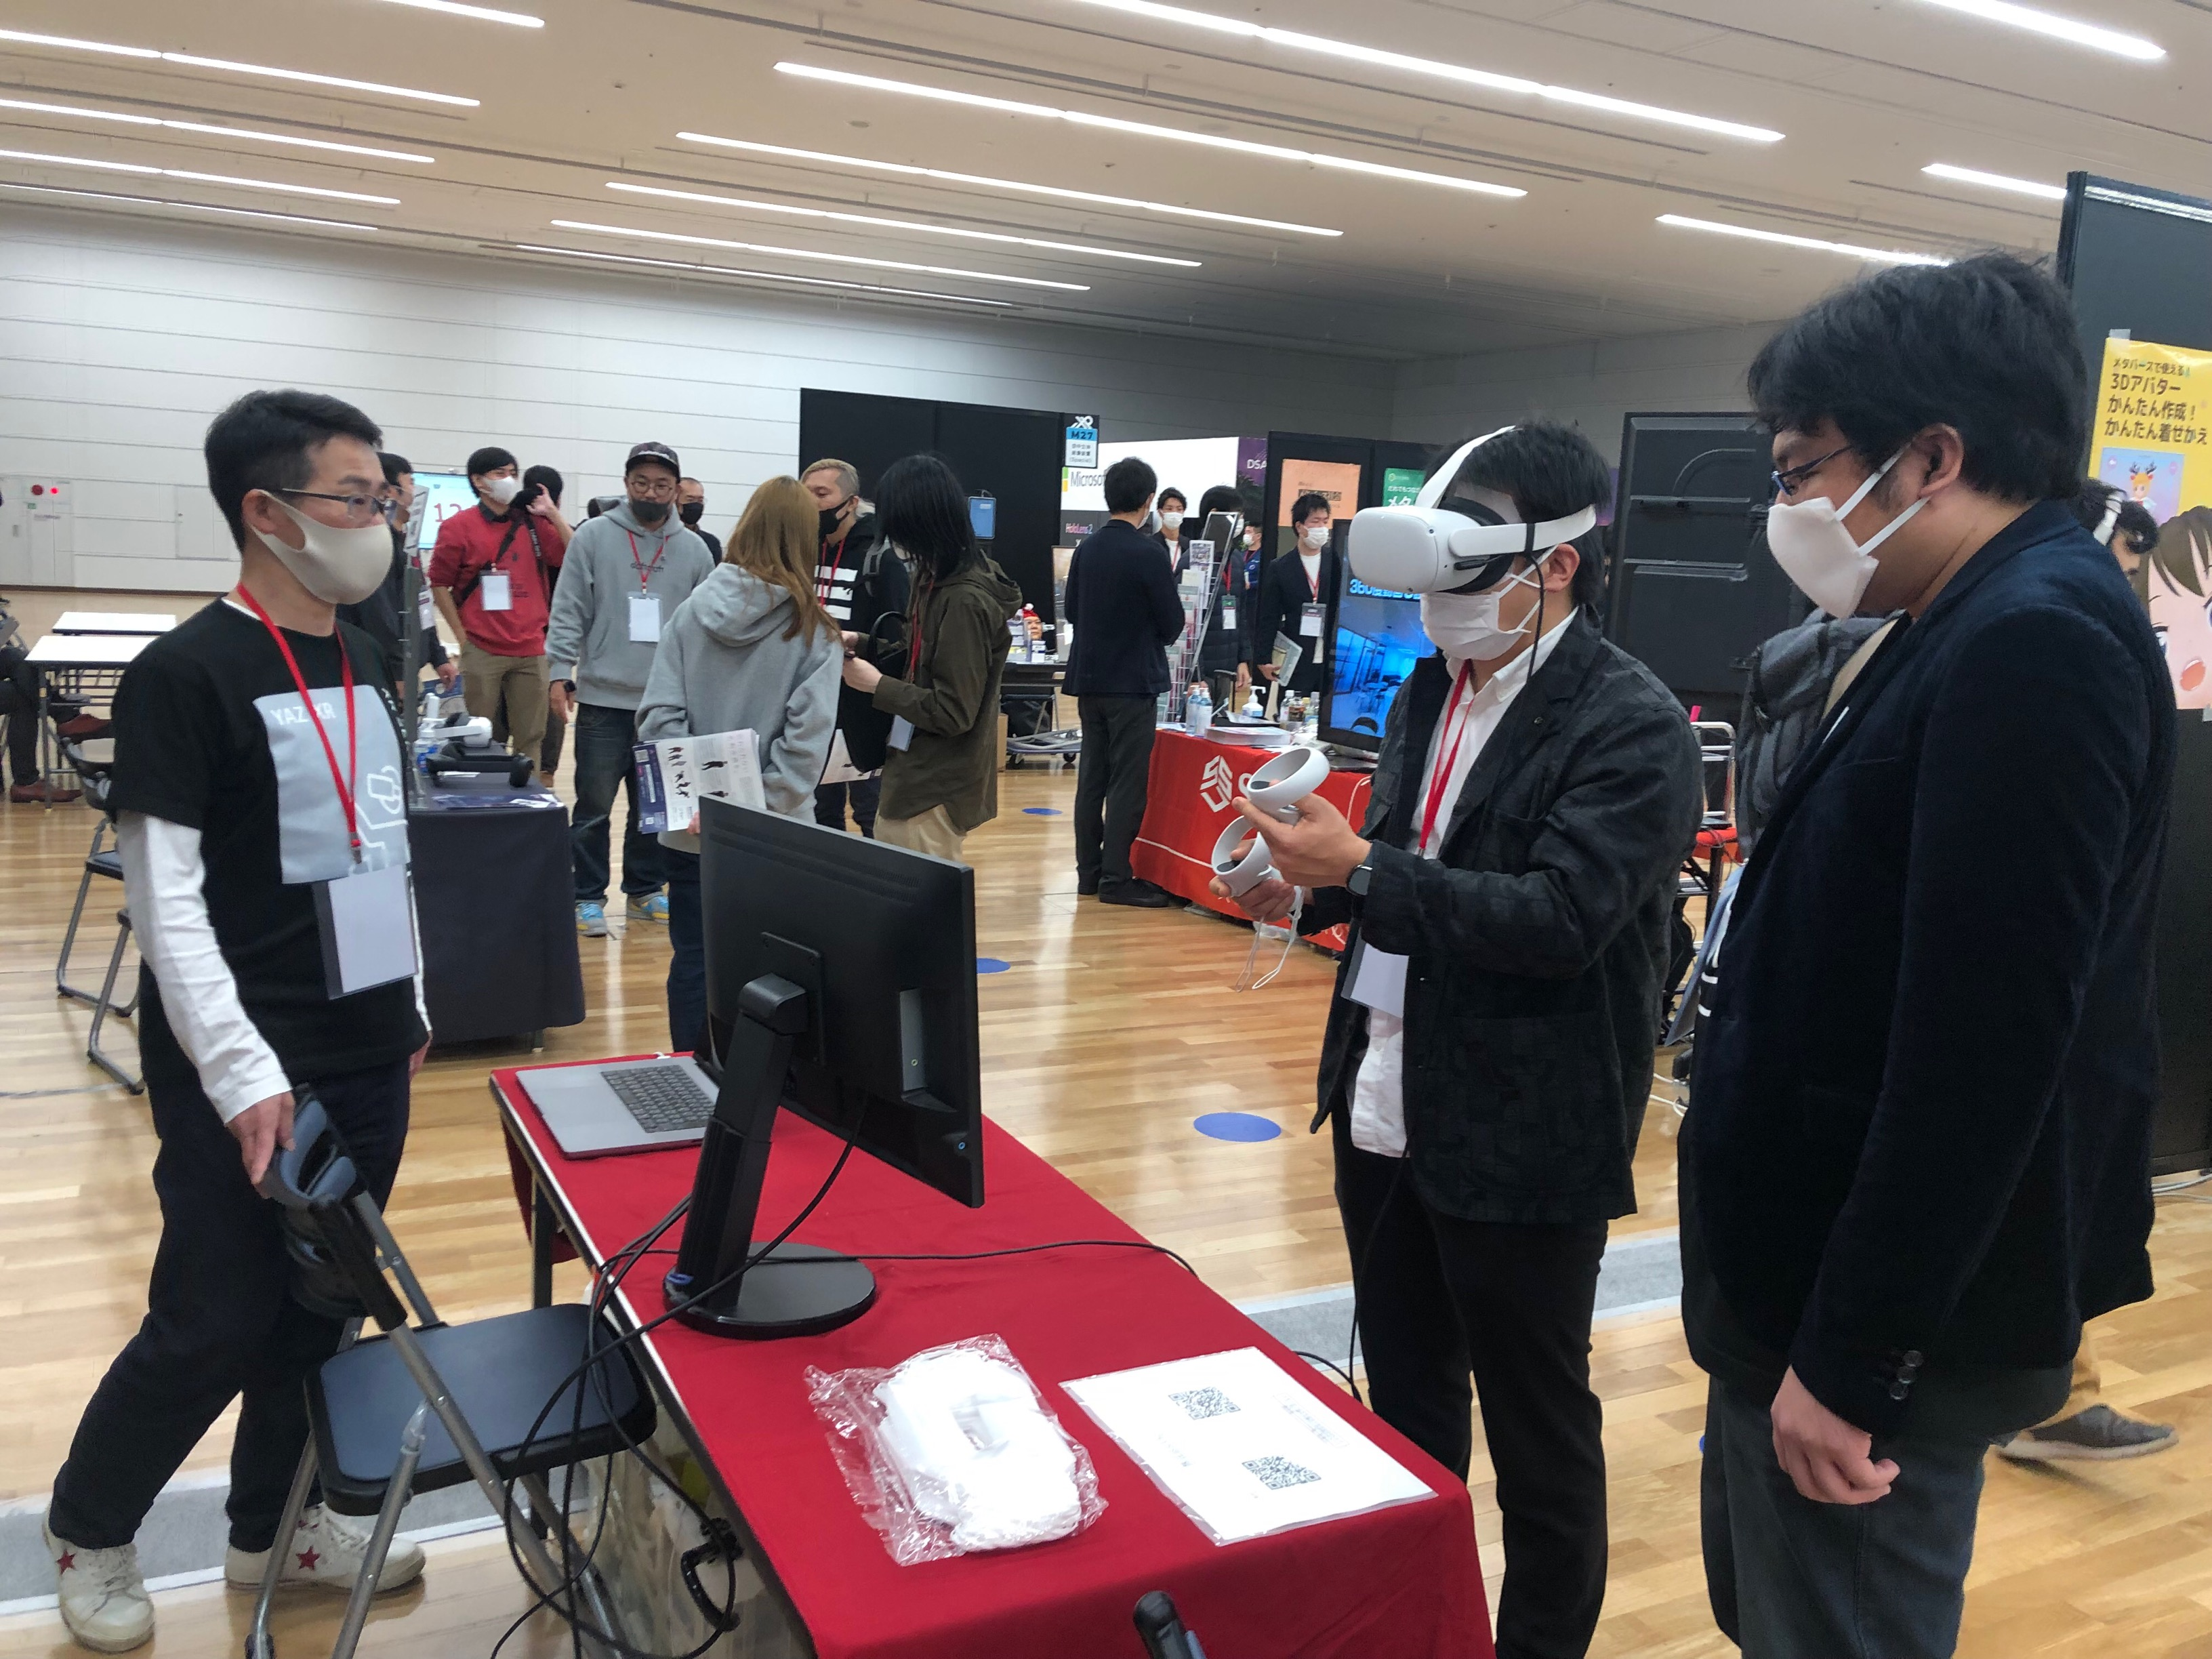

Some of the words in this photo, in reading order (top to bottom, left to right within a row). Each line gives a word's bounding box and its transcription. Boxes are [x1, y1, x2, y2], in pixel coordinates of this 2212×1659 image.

[2110, 373, 2182, 394] 3Dアバター
[1071, 430, 1093, 440] M27
[2104, 417, 2207, 445] かんたん着せかえ
